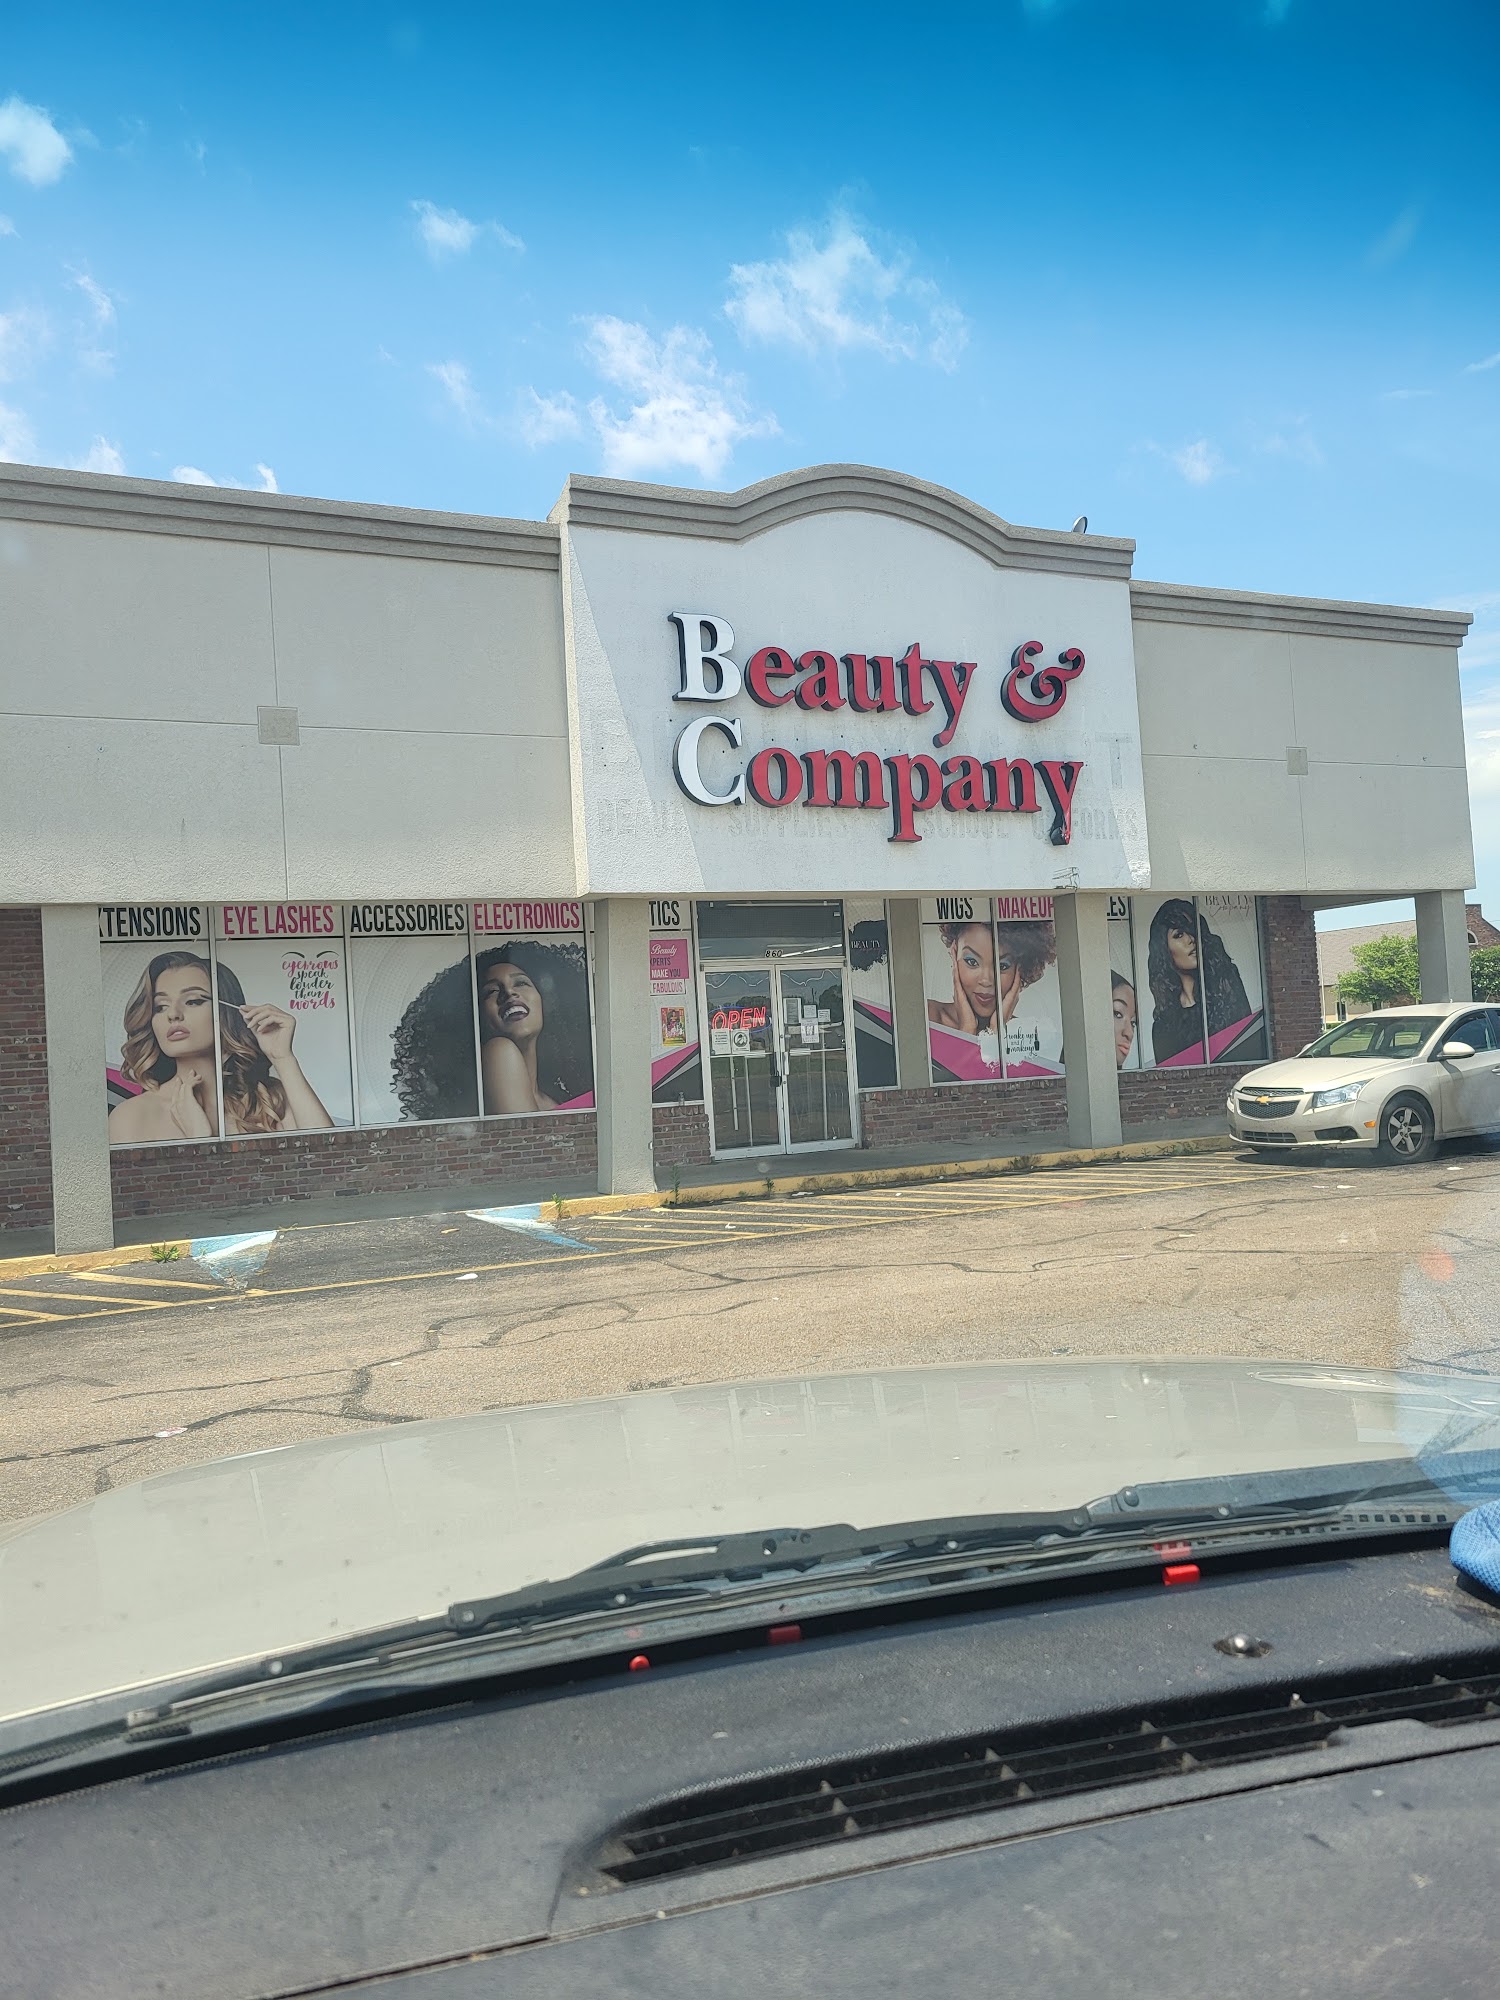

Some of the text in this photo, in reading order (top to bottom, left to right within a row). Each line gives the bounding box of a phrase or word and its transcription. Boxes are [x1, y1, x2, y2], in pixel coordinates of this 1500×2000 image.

[667, 611, 1086, 748] Beauty &
[672, 715, 1085, 846] Company
[350, 903, 465, 933] ACCESSORIES
[473, 902, 580, 931] ELECTRONICS
[649, 901, 680, 926] TICS
[936, 898, 973, 919] WIGS
[223, 905, 334, 935] EYE LASHES
[650, 944, 678, 957] Beauty
[765, 950, 783, 958] 860
[851, 940, 881, 949] BEAUTY
[282, 960, 338, 978] eyebrows
[295, 968, 328, 982] speak
[651, 968, 681, 979] MAKE YOU
[290, 976, 334, 990] louder
[652, 981, 683, 994] FABULOUS
[289, 990, 336, 1010] words
[294, 988, 324, 999] than
[712, 1006, 767, 1031] OPEN
